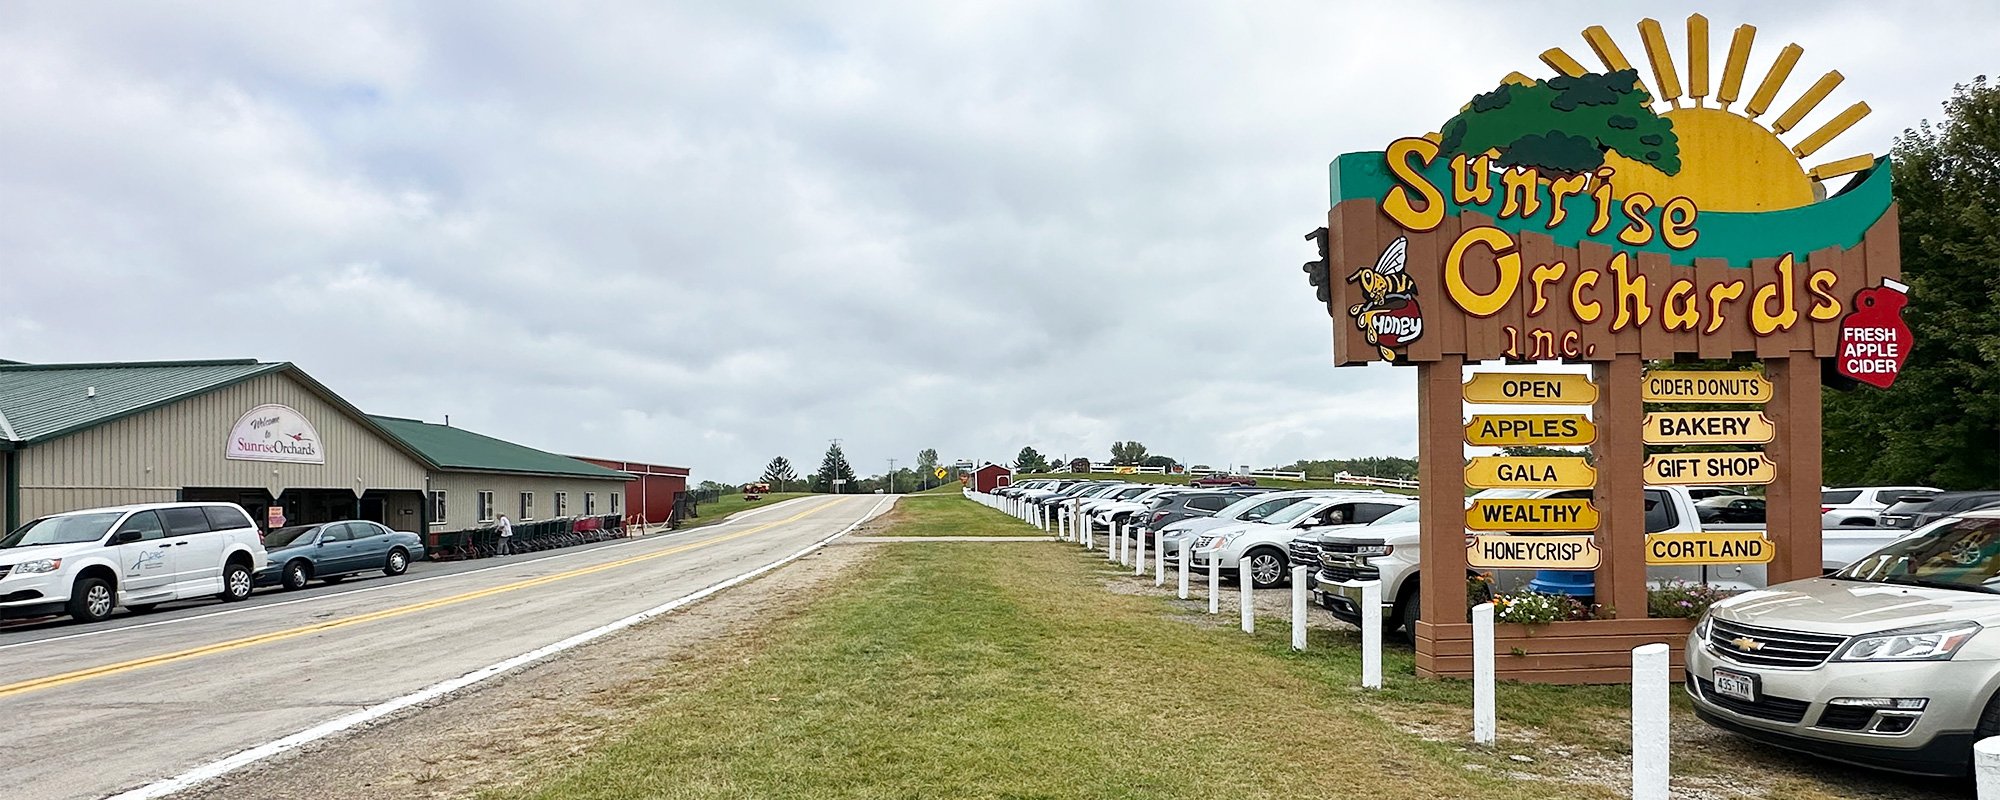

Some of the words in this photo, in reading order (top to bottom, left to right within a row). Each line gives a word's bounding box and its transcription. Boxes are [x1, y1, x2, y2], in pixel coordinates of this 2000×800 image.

[1380, 136, 1699, 249] Sunrise
[1443, 224, 1843, 336] Orchards
[1373, 316, 1422, 342] Honey
[1844, 327, 1897, 341] FRESH
[1844, 343, 1898, 357] APPLE
[1846, 359, 1898, 373] CIDER
[1502, 380, 1562, 398] OPEN
[1650, 378, 1693, 396] CIDER
[1697, 378, 1759, 396] DONUTS
[250, 416, 280, 430] Welcome
[1480, 419, 1579, 438] APPLES
[1659, 417, 1751, 436] BAKERY
[264, 430, 272, 439] to
[1497, 464, 1558, 482] GALA
[1657, 458, 1701, 477] GIFT
[1706, 458, 1760, 477] SHOP
[1482, 504, 1582, 523] WEALTHY
[1483, 541, 1583, 561] HONEYCRISP
[1652, 540, 1762, 558] CORTLAND
